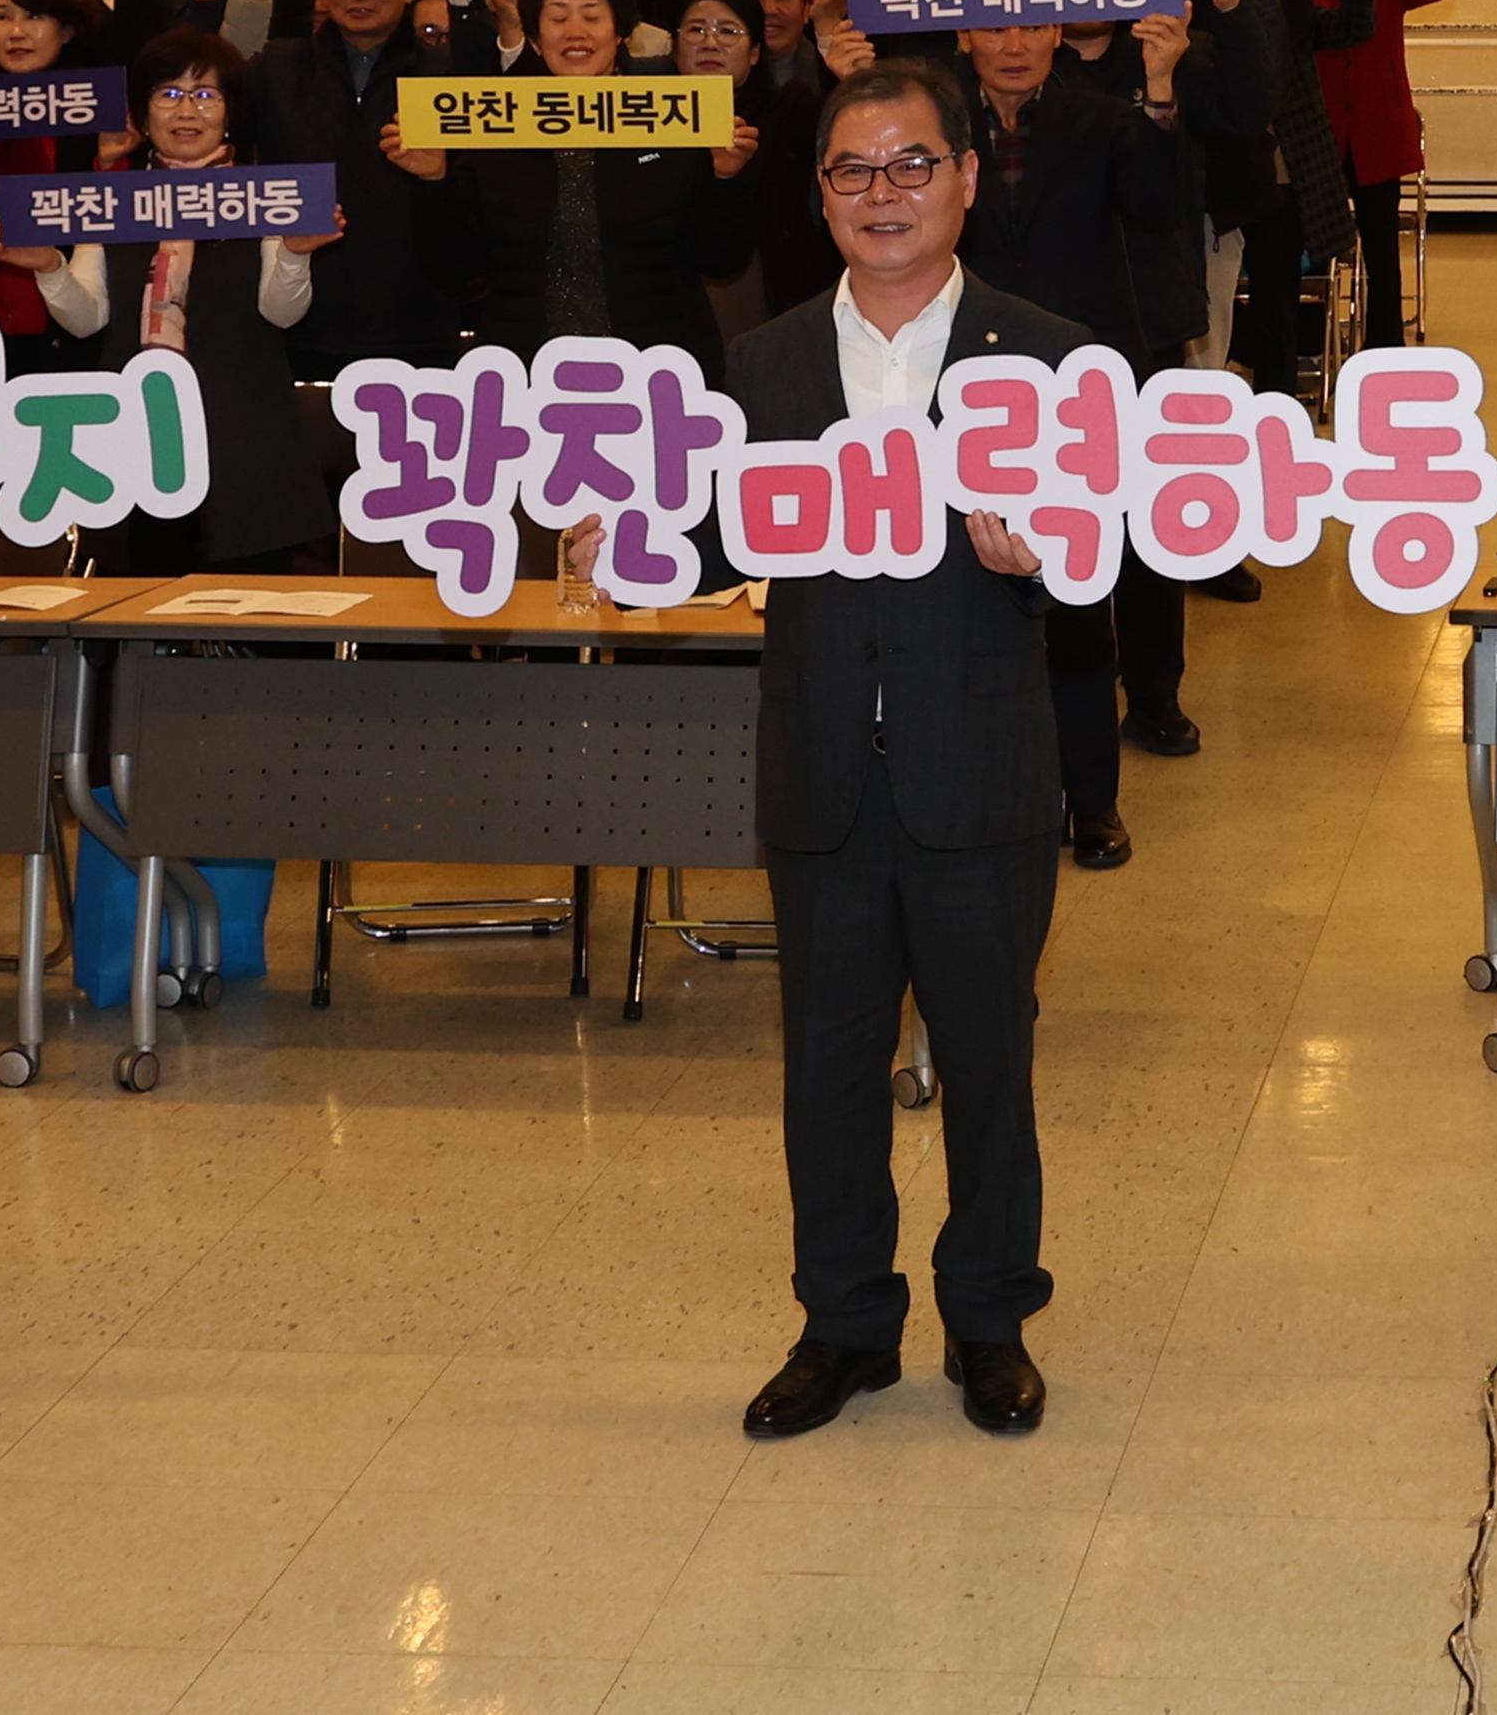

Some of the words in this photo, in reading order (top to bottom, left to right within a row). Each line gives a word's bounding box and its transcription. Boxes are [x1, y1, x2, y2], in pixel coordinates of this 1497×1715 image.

[432, 90, 518, 134] 알찬
[531, 90, 701, 134] 동네복지
[30, 186, 118, 234] 꽉찬
[133, 179, 304, 230] 매력하동
